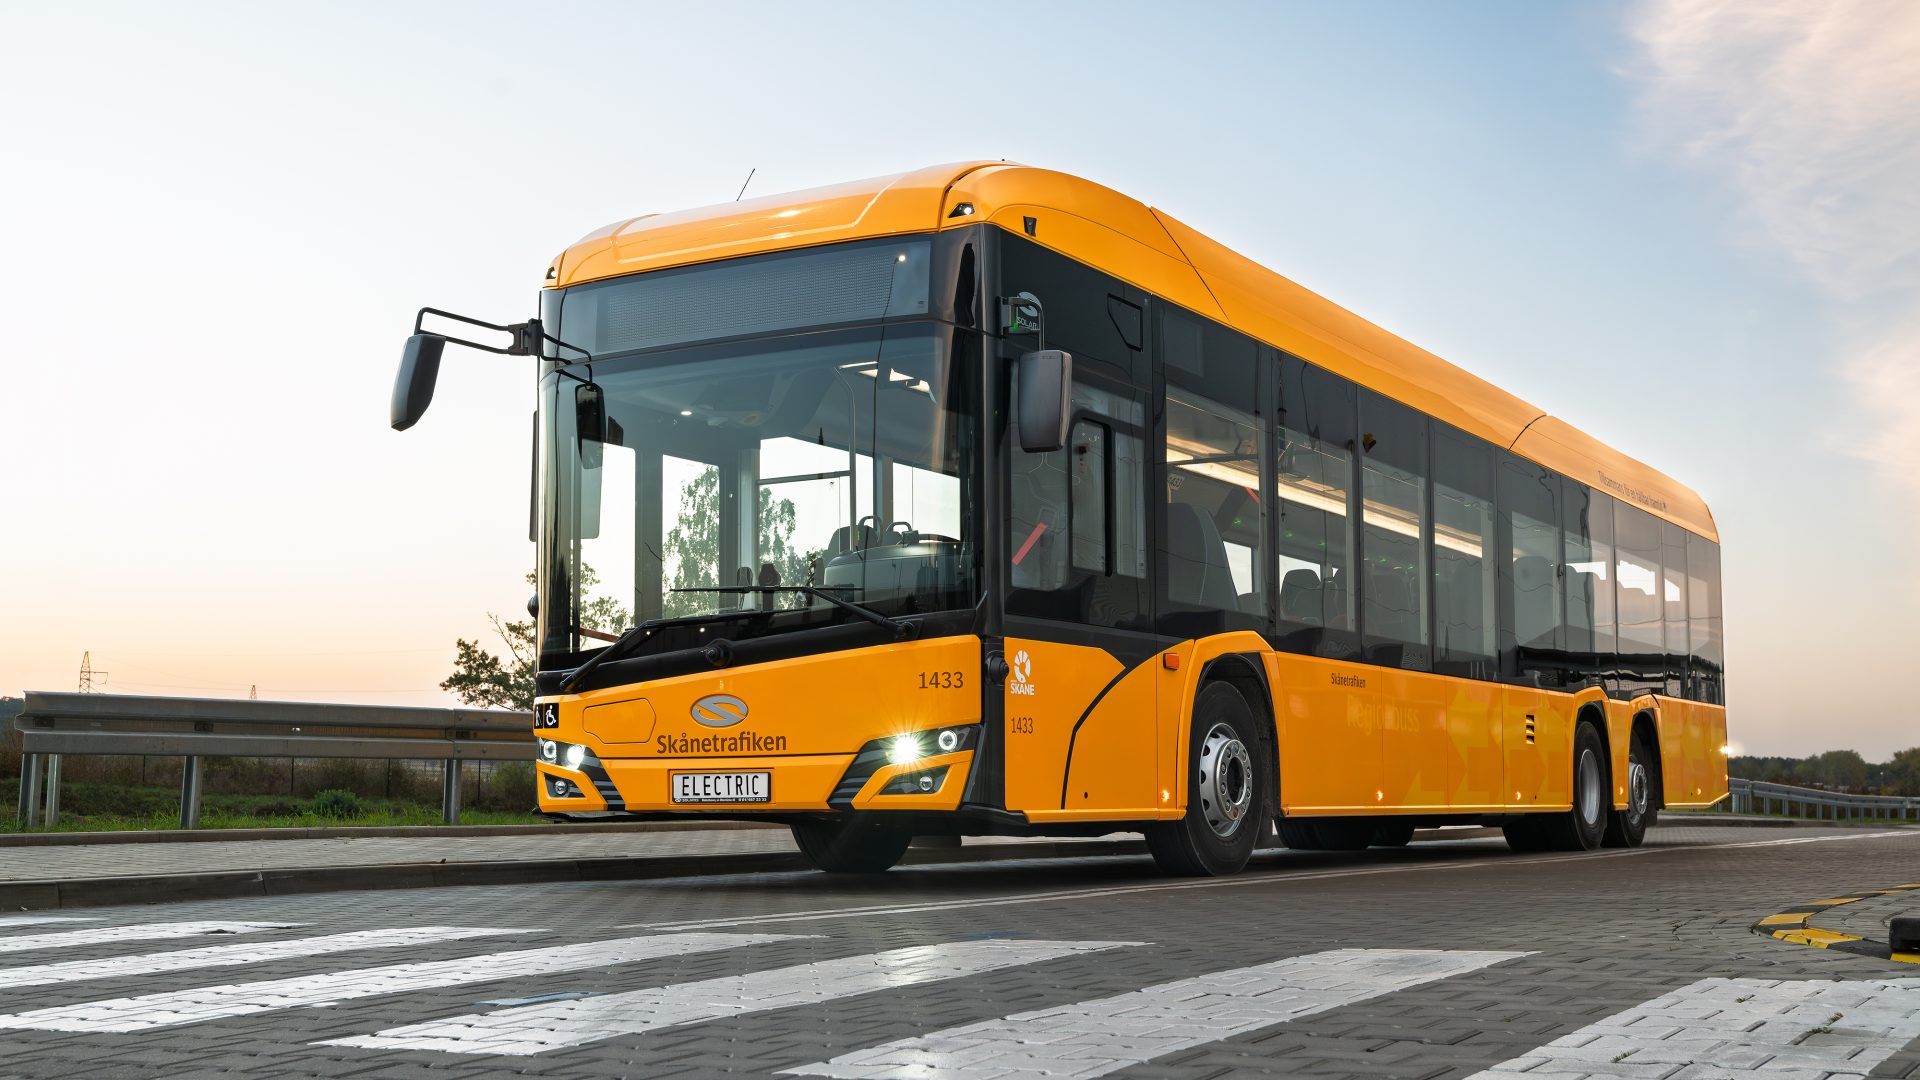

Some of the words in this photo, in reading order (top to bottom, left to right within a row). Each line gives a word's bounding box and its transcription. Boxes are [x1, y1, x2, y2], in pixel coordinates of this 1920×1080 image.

[918, 671, 964, 689] 1433
[1331, 672, 1365, 688] Skånetrafiken
[1011, 717, 1034, 734] 1433
[657, 731, 787, 754] Skånetrafiken
[682, 775, 760, 796] ELECTRIC
